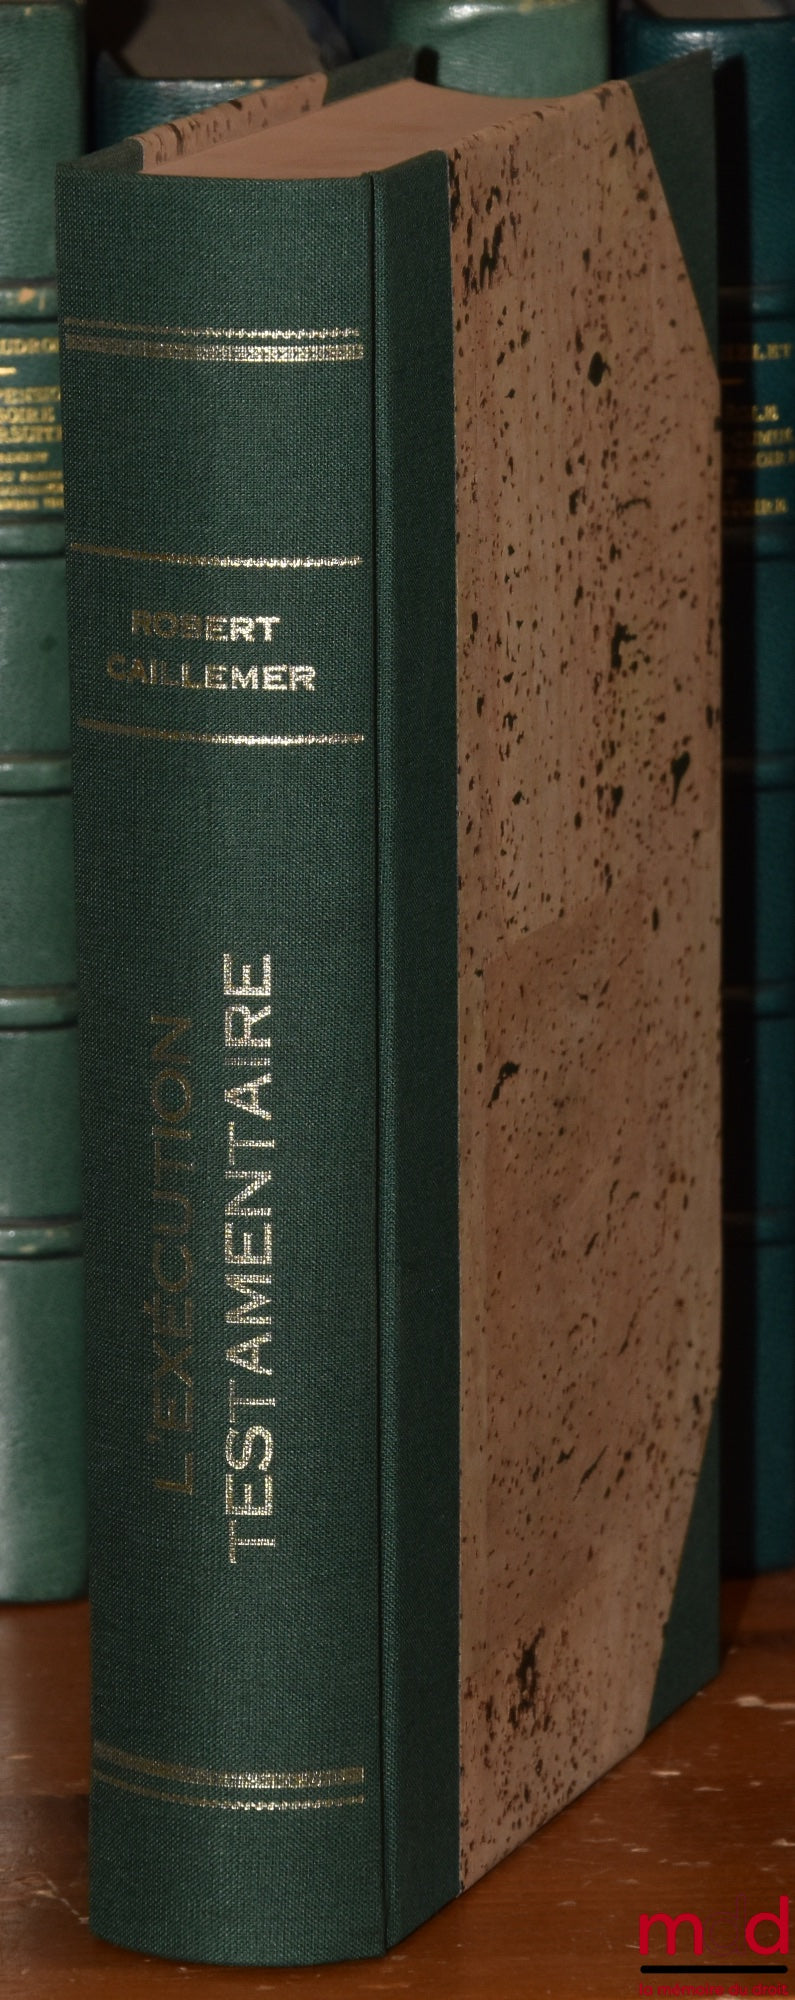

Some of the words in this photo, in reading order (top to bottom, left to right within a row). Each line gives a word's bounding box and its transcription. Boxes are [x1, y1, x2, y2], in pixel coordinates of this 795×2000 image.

[106, 651, 316, 691] CAILLEMER
[131, 609, 281, 642] ROBERT
[144, 1014, 195, 1496] L'EXÉCUTION
[223, 952, 276, 1564] TESTAMENTAIRE
